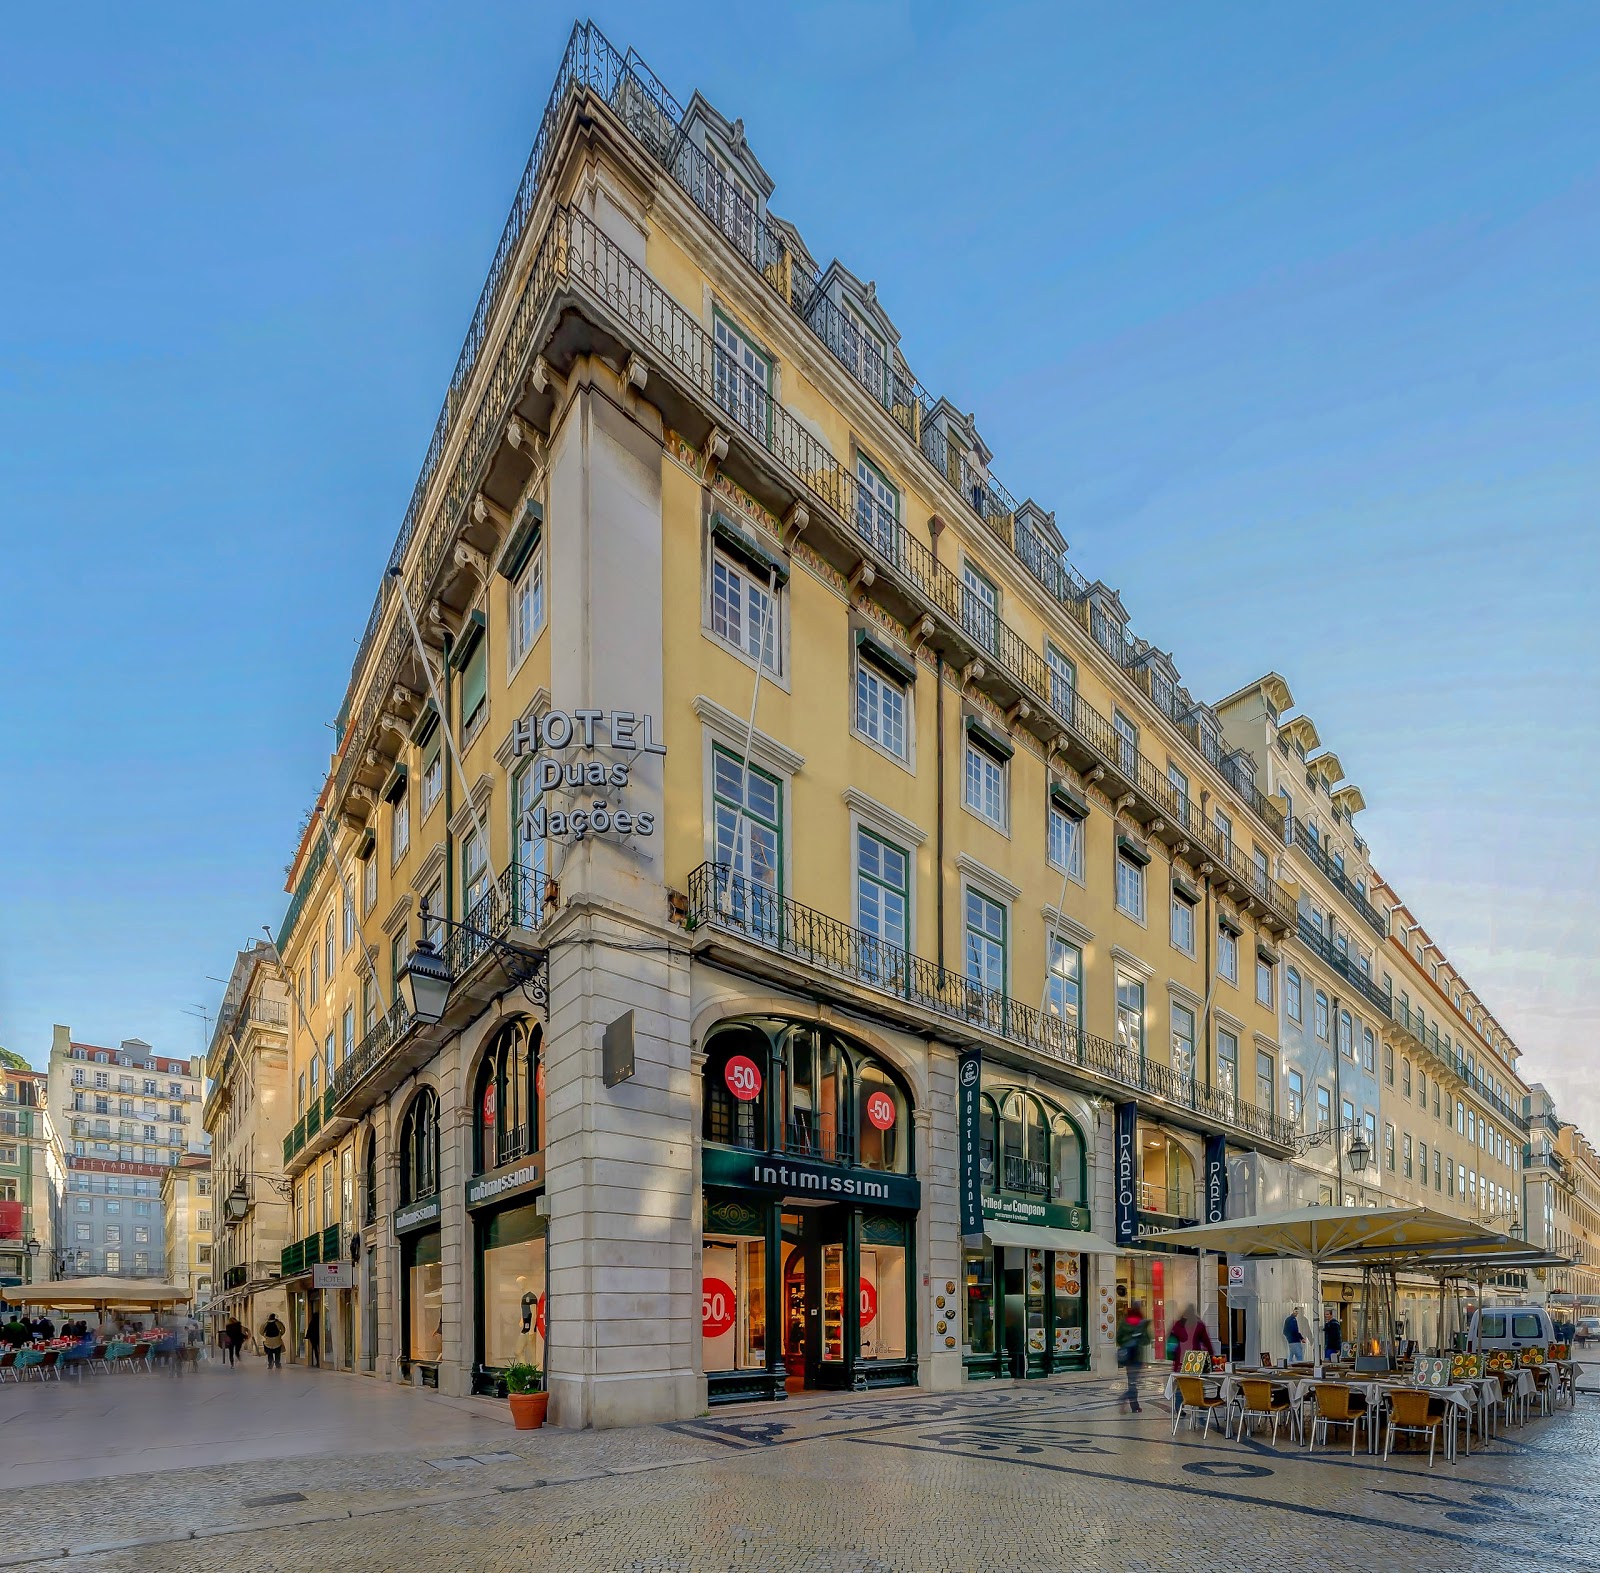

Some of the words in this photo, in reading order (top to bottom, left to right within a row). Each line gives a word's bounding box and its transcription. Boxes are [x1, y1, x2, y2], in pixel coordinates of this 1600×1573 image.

[512, 709, 667, 756] HOTEL
[540, 758, 629, 791] Duas
[522, 800, 655, 841] Nações
[966, 1090, 975, 1226] Restaurante
[470, 1165, 535, 1202] intimissimi
[754, 1166, 889, 1199] intimissimi
[1120, 1134, 1132, 1235] PARFOIS
[1003, 1203, 1012, 1211] and
[1013, 1199, 1046, 1217] Company
